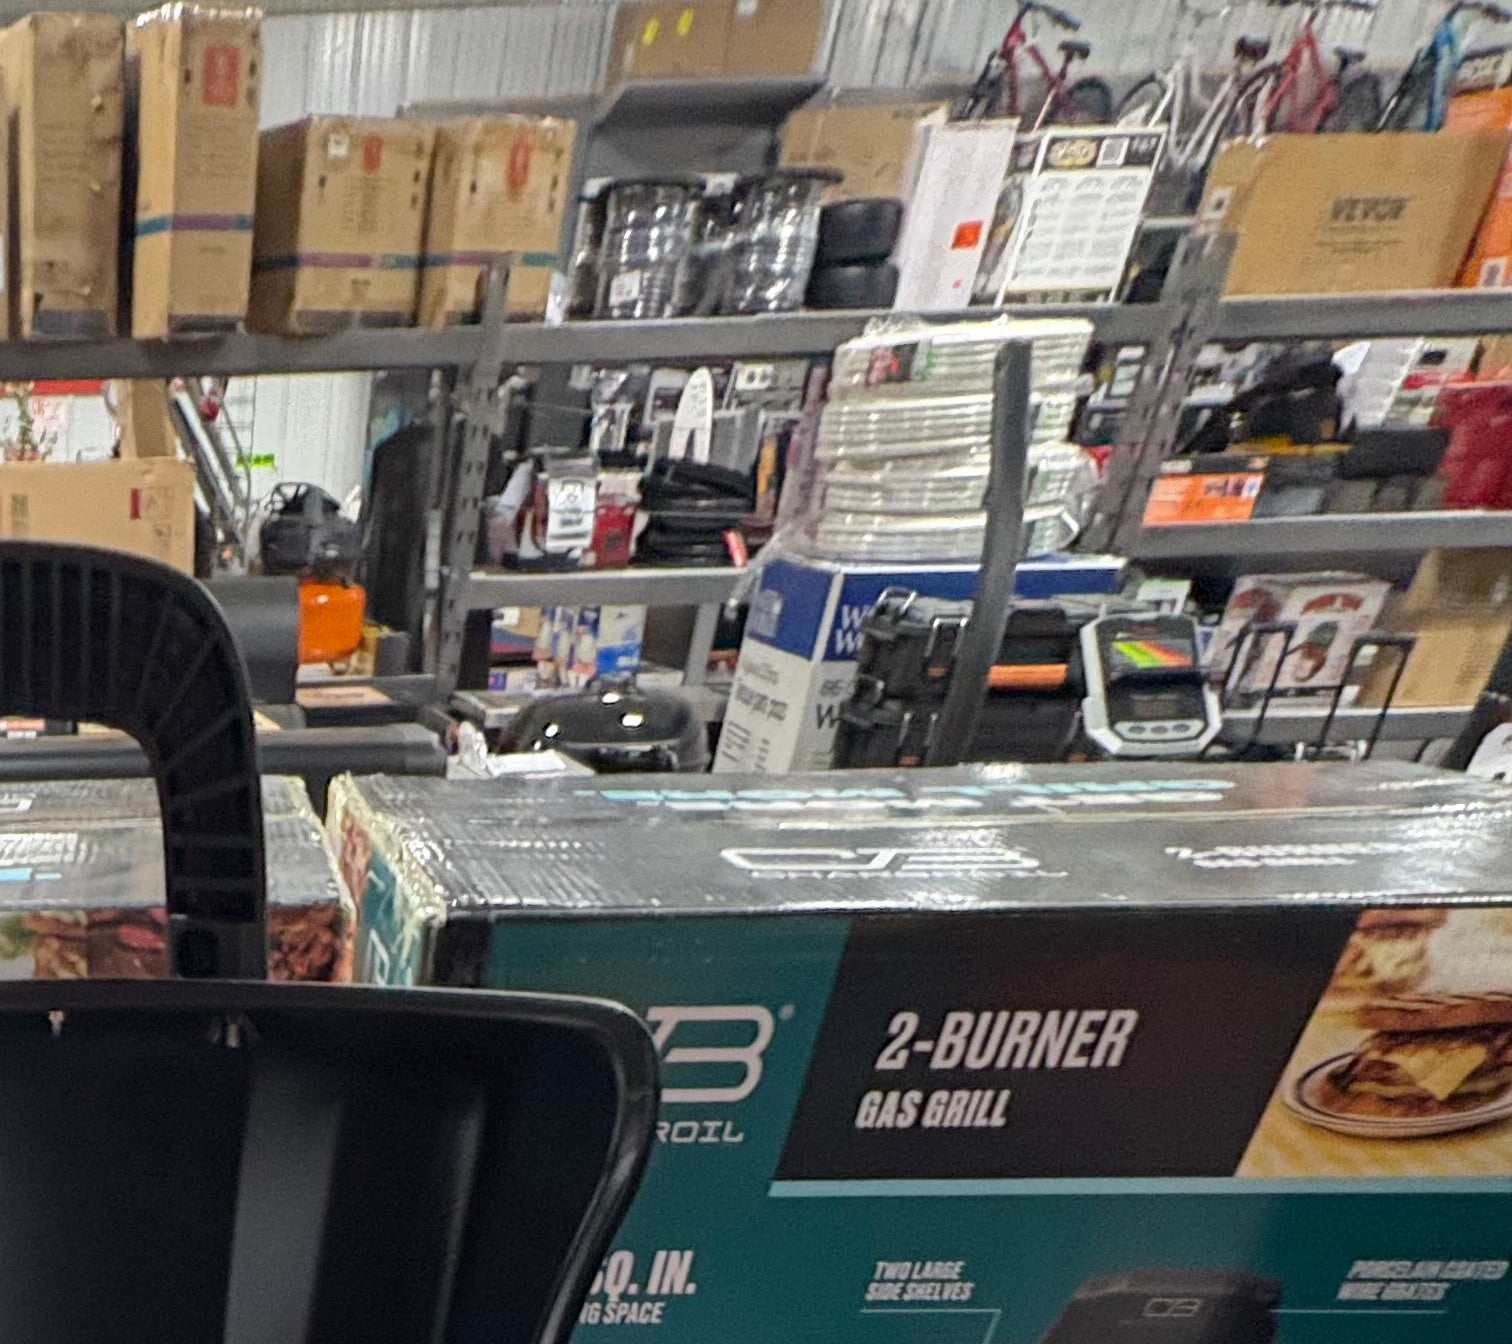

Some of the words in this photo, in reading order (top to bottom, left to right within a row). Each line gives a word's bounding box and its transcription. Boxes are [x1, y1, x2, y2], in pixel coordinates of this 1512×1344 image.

[645, 1005, 775, 1103] B
[875, 1008, 1138, 1074] 2-BURNER
[855, 1091, 917, 1130] GAS
[921, 1089, 1008, 1130] GRILL
[646, 1249, 697, 1295] IN.
[601, 1301, 666, 1325] SPACE
